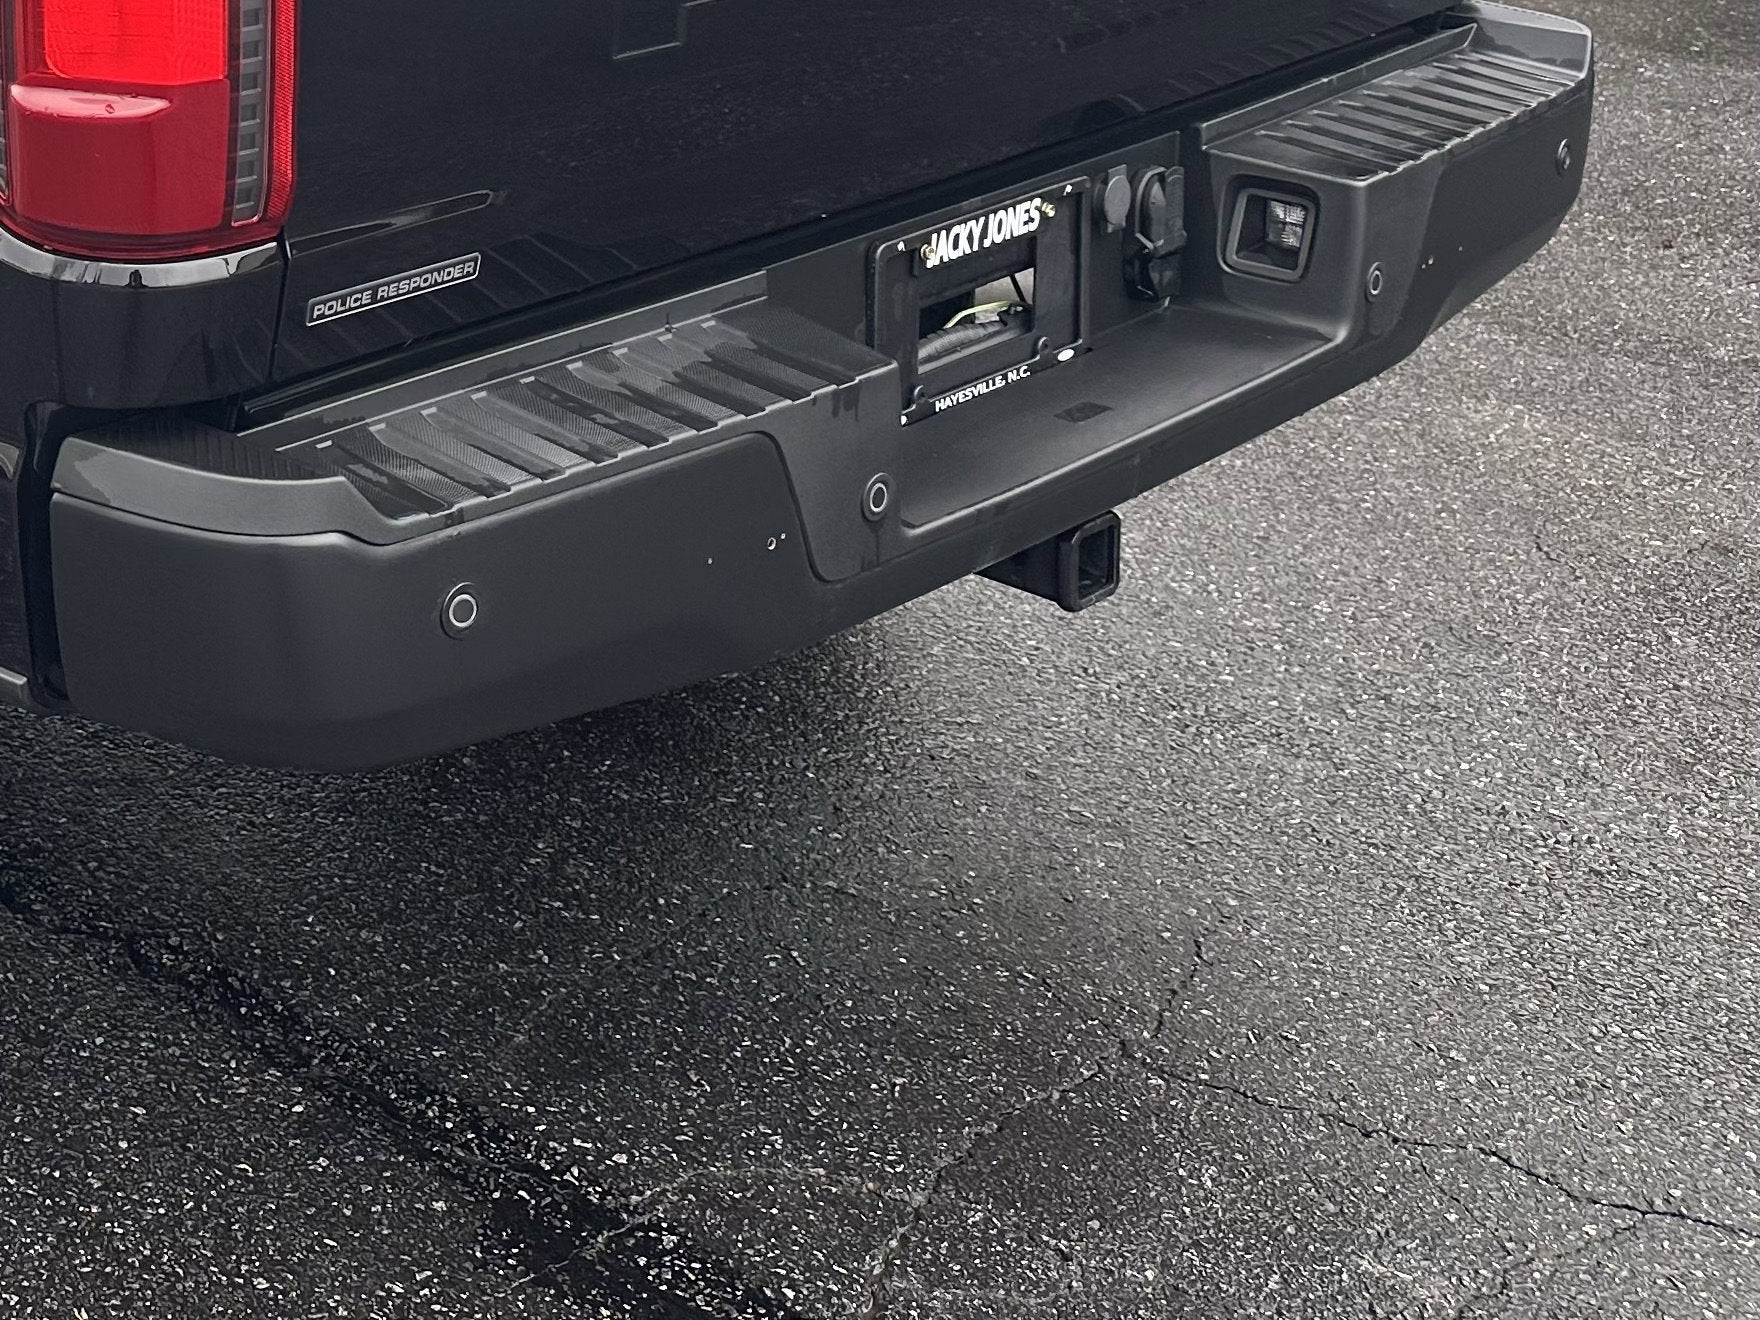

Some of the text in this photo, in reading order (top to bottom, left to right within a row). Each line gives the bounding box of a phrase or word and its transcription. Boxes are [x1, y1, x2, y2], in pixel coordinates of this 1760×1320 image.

[926, 198, 1041, 268] JACKY JONES
[312, 261, 475, 319] POLICE RESPONDER
[934, 366, 1031, 413] HAYESVILLE, N.C.
